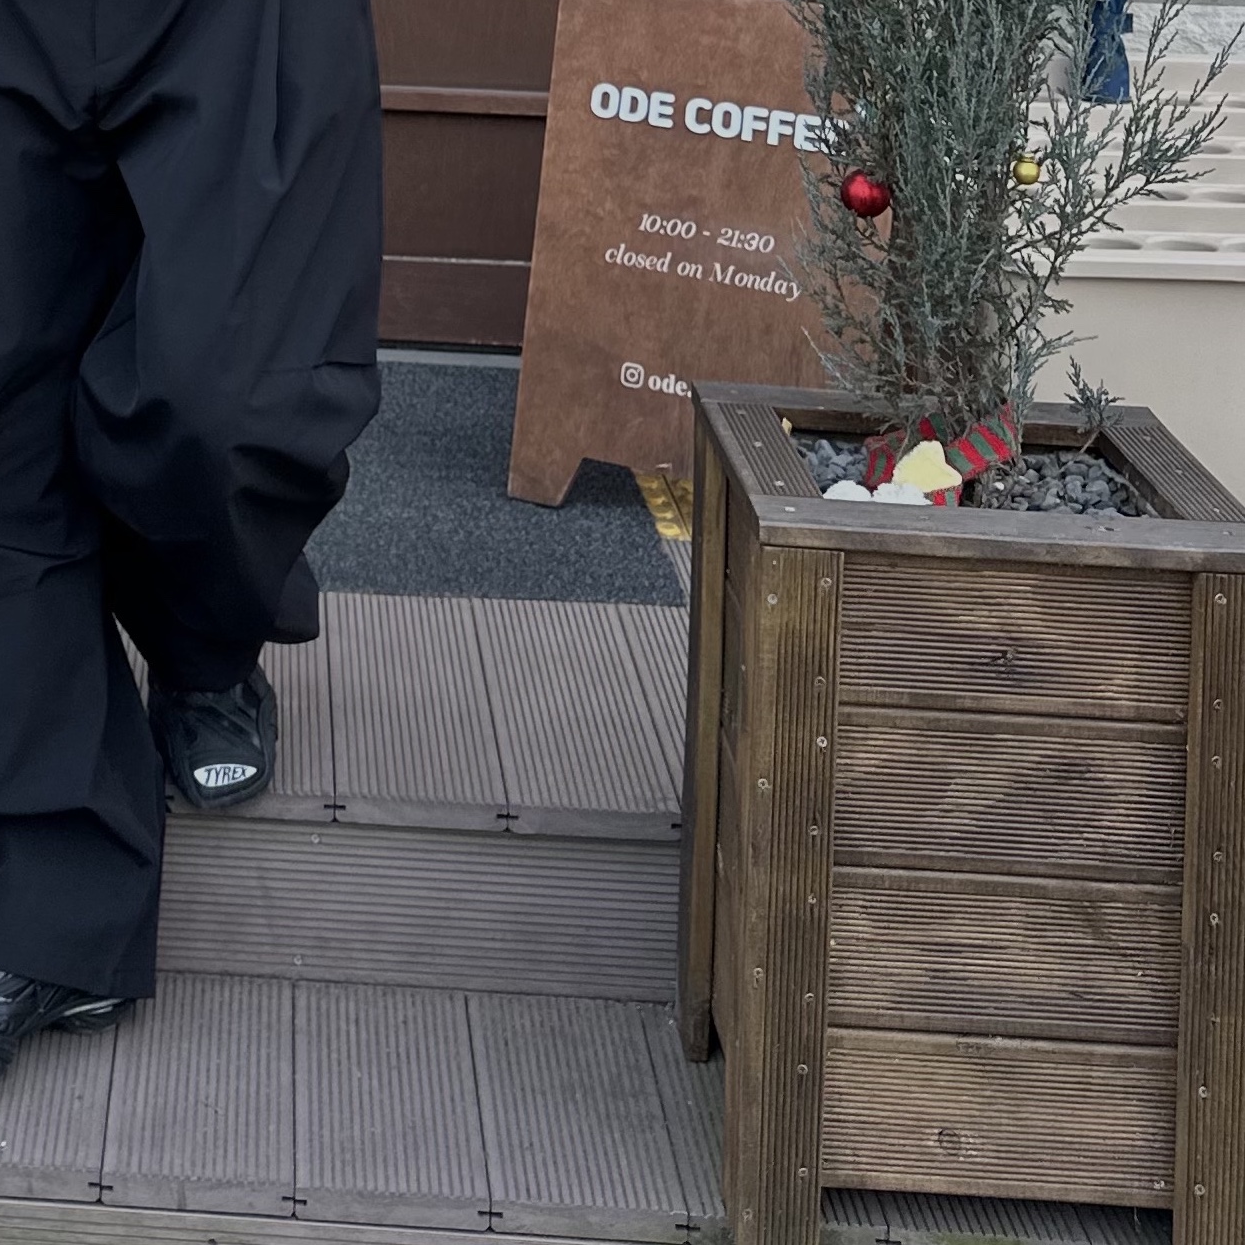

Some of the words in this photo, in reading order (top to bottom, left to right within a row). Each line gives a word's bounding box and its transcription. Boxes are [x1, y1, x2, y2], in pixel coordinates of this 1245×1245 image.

[590, 82, 676, 129] ODE
[638, 213, 697, 240] 10:00
[716, 227, 775, 254] 21:30
[604, 243, 673, 273] closed
[676, 260, 703, 280] on
[708, 262, 802, 302] Monday
[204, 766, 247, 785] TYREX
